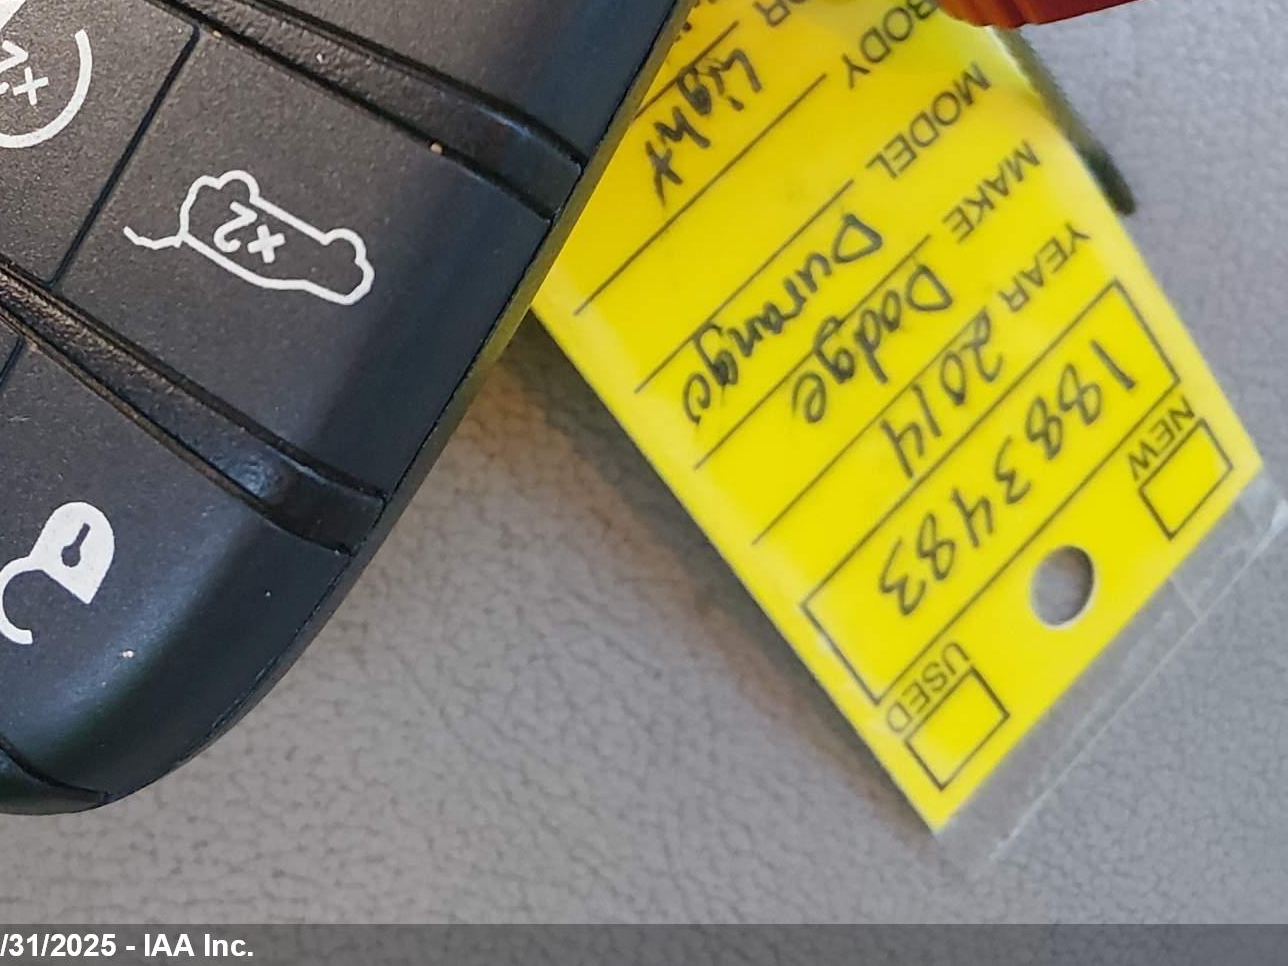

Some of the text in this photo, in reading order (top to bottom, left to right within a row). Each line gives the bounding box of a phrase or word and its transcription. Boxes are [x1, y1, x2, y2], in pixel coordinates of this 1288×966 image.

[865, 61, 992, 180] MODEL
[942, 140, 1041, 244] MAKE
[683, 213, 884, 423] Durango
[998, 222, 1091, 313] YEAR
[792, 264, 953, 423] Dodge
[879, 307, 1004, 478] 2014
[878, 340, 1137, 616] 1883483
[1128, 396, 1195, 482] NEW
[884, 641, 971, 735] USED
